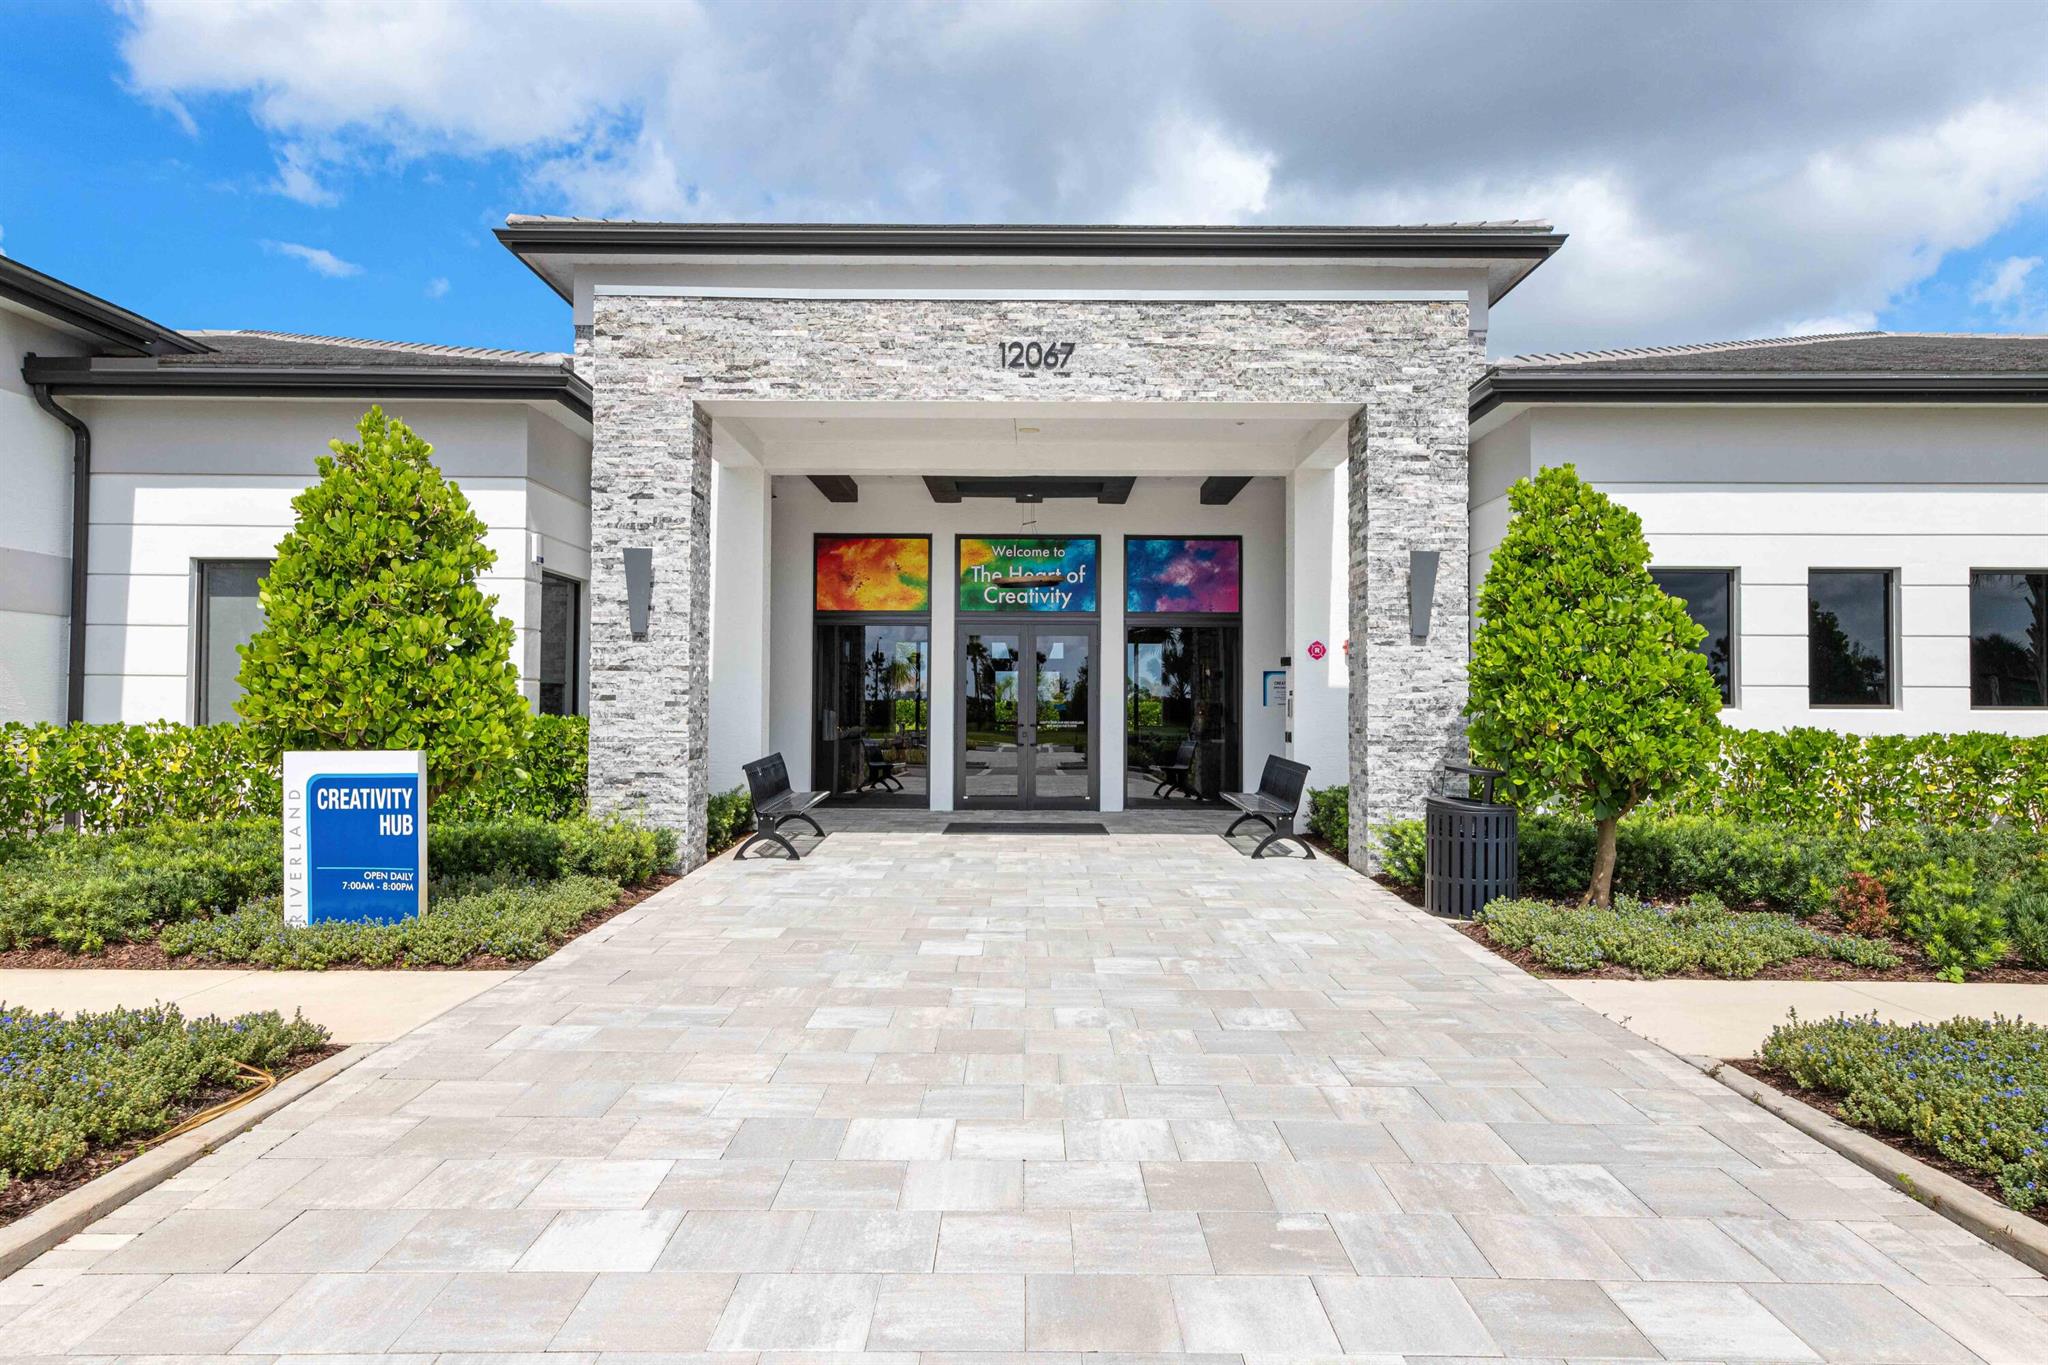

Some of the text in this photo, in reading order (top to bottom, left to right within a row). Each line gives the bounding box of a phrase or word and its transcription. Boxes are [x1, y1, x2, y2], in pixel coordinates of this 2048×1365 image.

[998, 341, 1076, 370] 12067
[992, 545, 1066, 557] Welcome to
[971, 565, 1002, 583] The
[1066, 565, 1086, 583] of
[984, 587, 1072, 609] Creativity
[317, 788, 413, 810] CREATIVITY
[379, 814, 413, 836] HUB
[289, 789, 302, 922] RIVERLAND
[342, 881, 375, 890] 7:00AM
[382, 882, 414, 891] 8:00PM
[363, 871, 414, 881] OPEN DAILY
